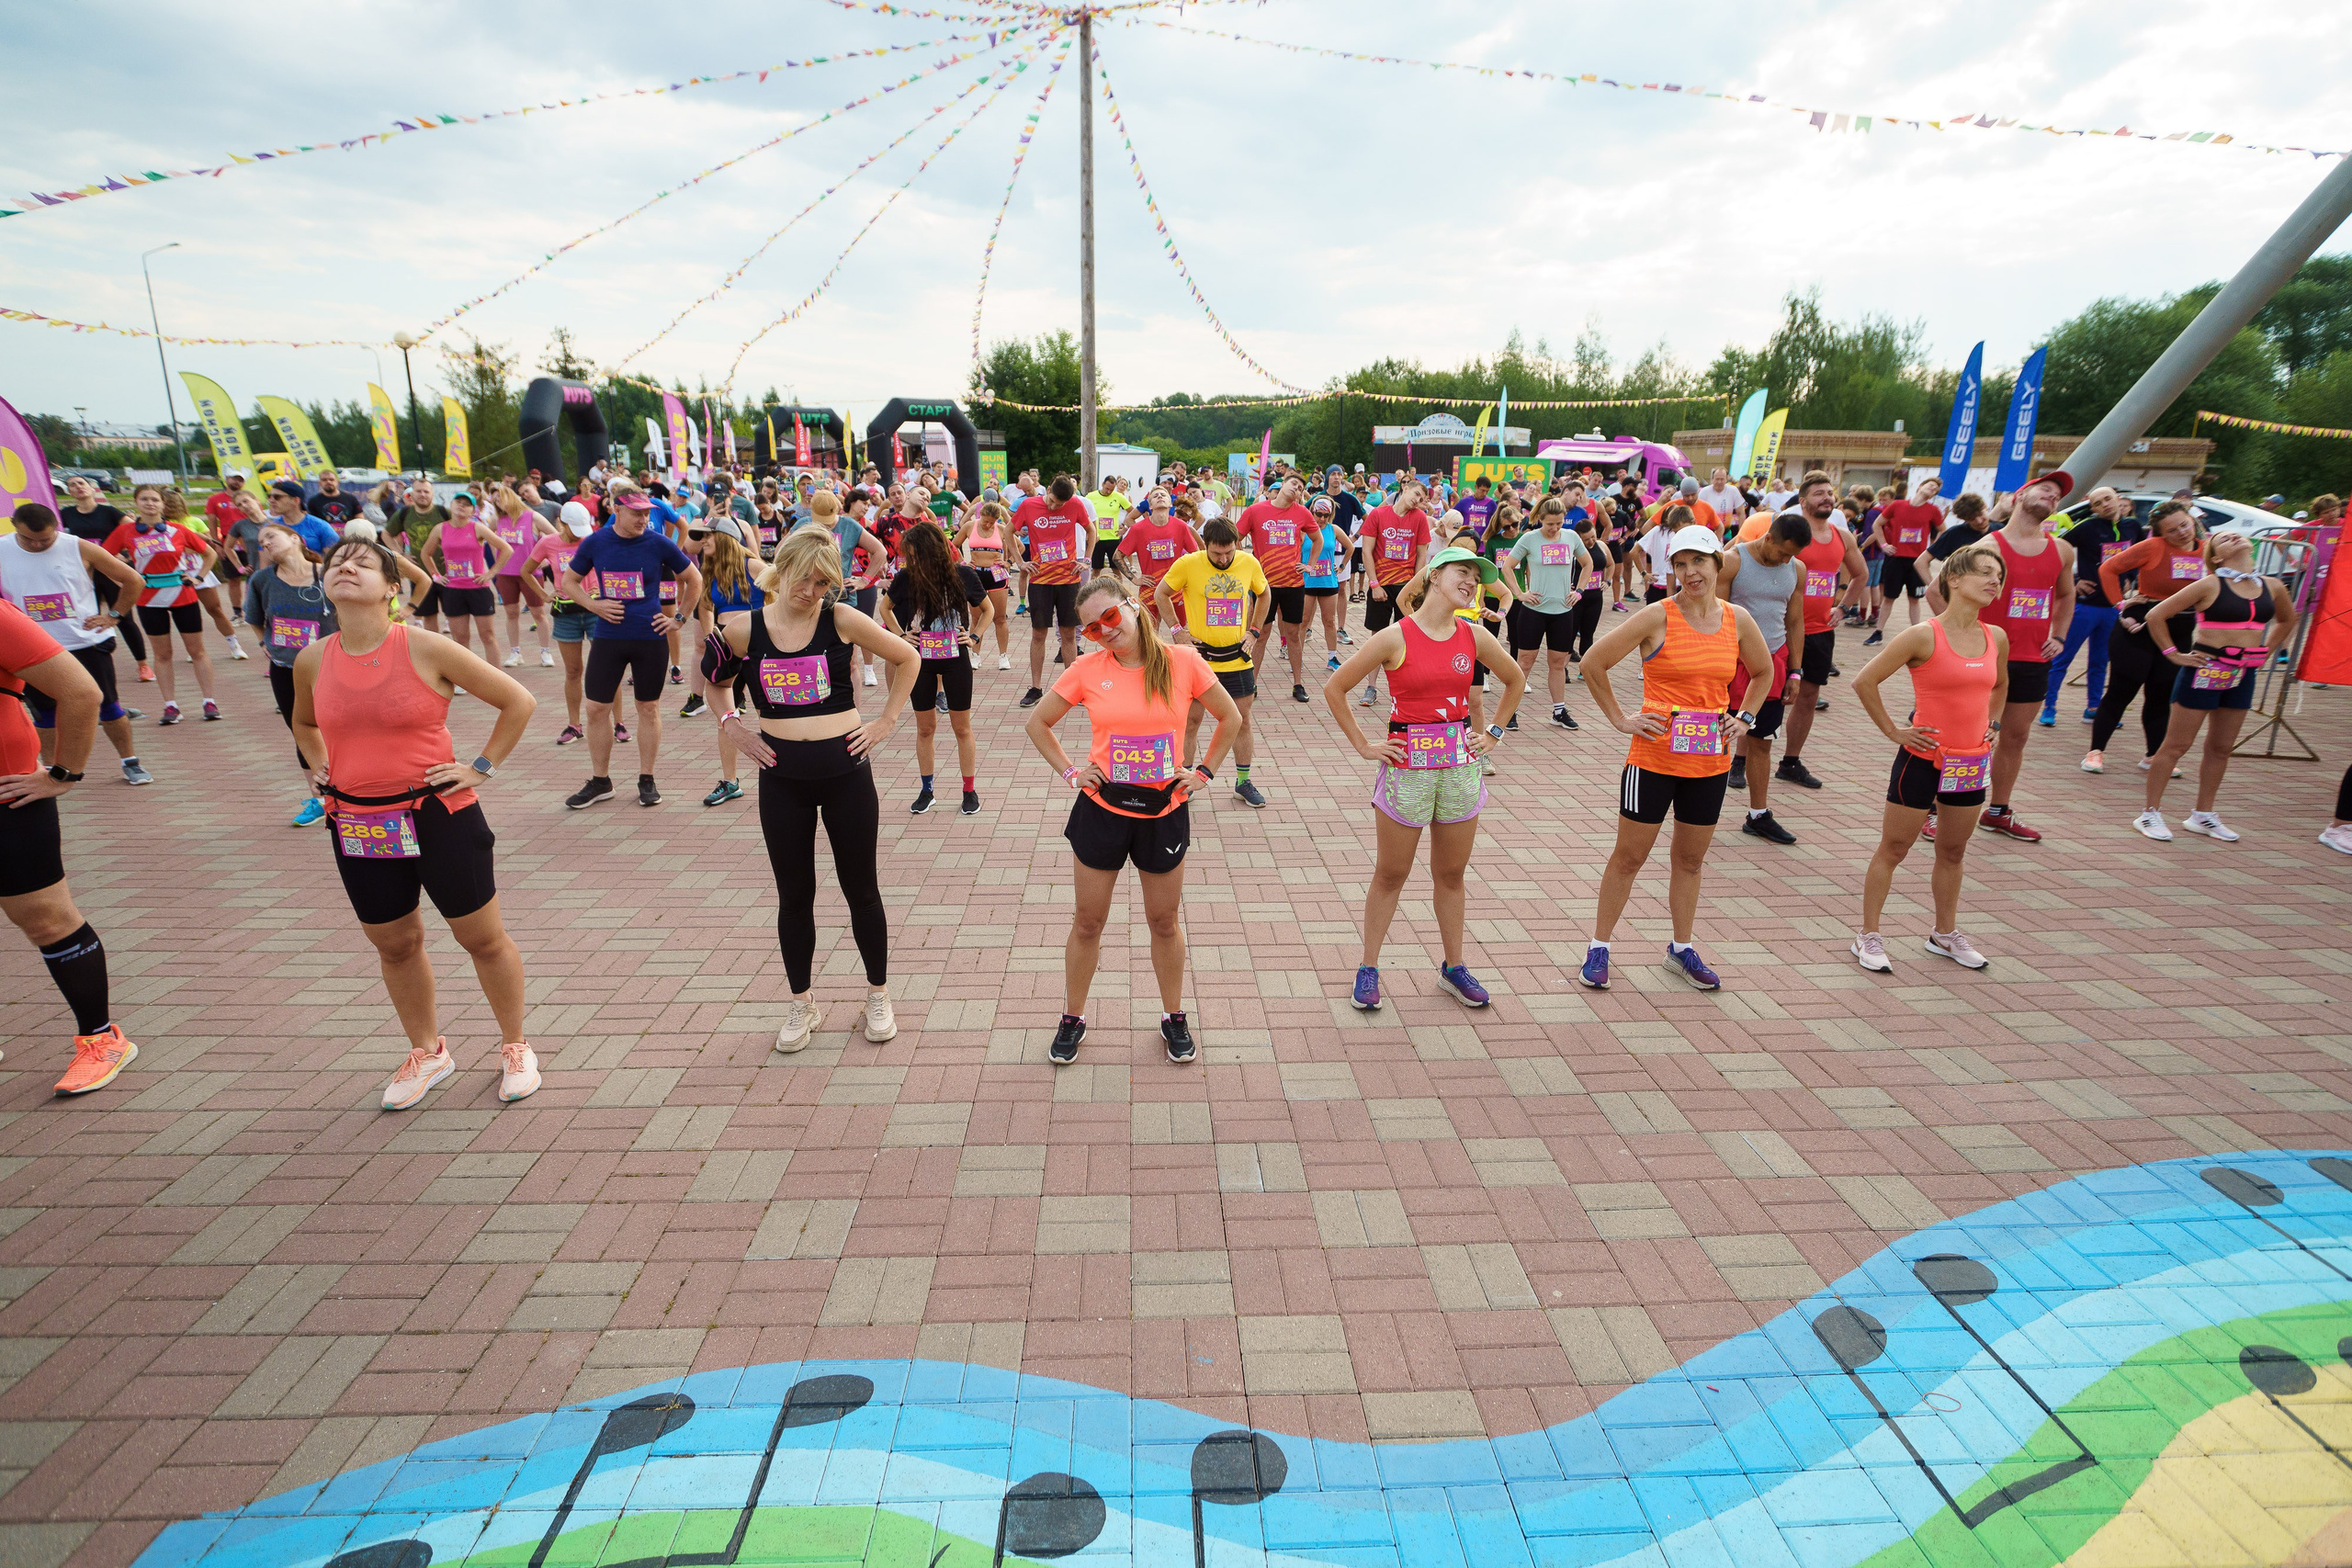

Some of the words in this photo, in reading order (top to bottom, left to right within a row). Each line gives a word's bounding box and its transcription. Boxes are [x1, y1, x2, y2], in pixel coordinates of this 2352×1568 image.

[908, 404, 953, 416] СТАРТ
[1950, 374, 1976, 465] GEELY
[2011, 381, 2035, 461] GEELY
[1409, 425, 1453, 438] Призовые
[982, 463, 1004, 471] RUN
[1465, 463, 1545, 482] RUTS
[1040, 547, 1057, 555] 247
[605, 580, 628, 588] 272
[1808, 578, 1828, 587] 174
[27, 601, 57, 611] 284
[2012, 597, 2037, 607] 175
[1208, 606, 1227, 615] 151
[274, 625, 301, 637] 253
[922, 639, 944, 648] 192
[763, 672, 801, 686] 128
[2198, 668, 2233, 680] 058
[1674, 723, 1709, 737] 183
[1410, 737, 1447, 750] 184
[1113, 749, 1156, 763] 043
[1942, 765, 1980, 777] 263
[340, 823, 388, 839] 286
